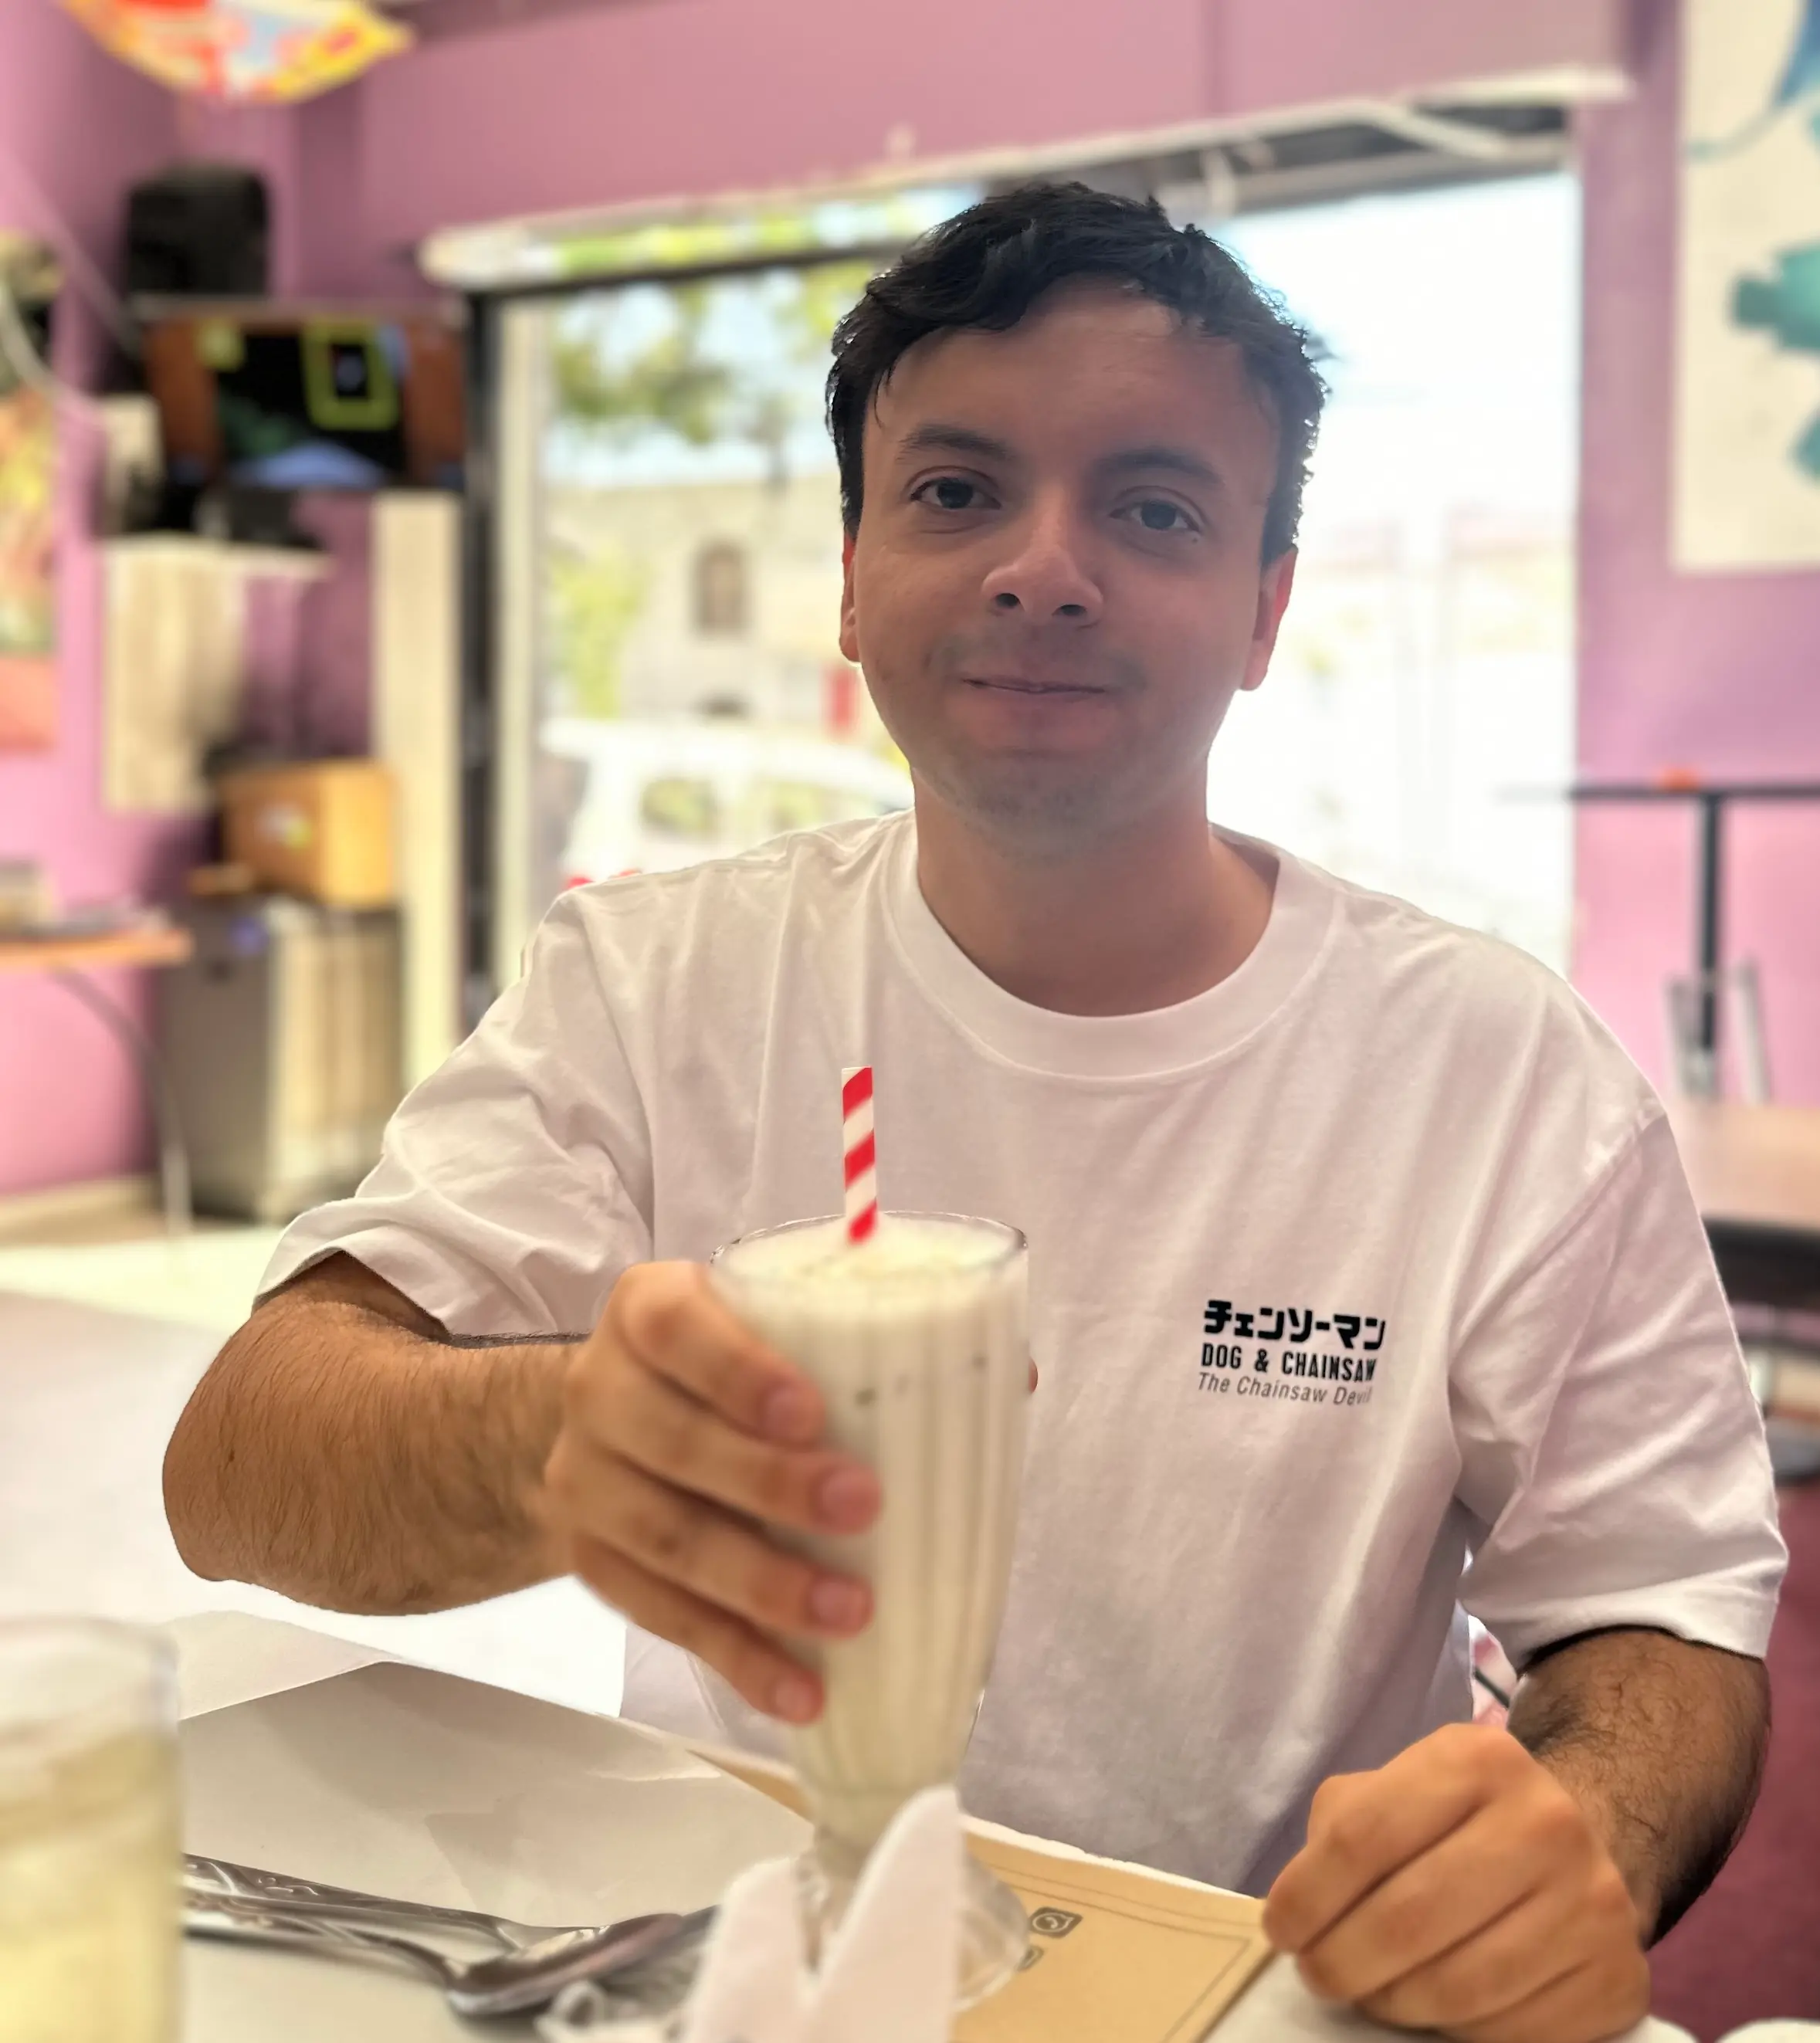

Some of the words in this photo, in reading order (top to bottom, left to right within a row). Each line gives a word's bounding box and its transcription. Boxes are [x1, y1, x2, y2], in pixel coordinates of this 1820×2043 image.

[1204, 1299, 1386, 1350] チェンソーマン
[1201, 1343, 1242, 1369] DOG
[1254, 1349, 1269, 1373] &
[1282, 1350, 1378, 1382] CHAINSAW
[1198, 1371, 1230, 1393] The
[1237, 1376, 1327, 1403] Chainsaw
[1334, 1385, 1372, 1405] Devil
